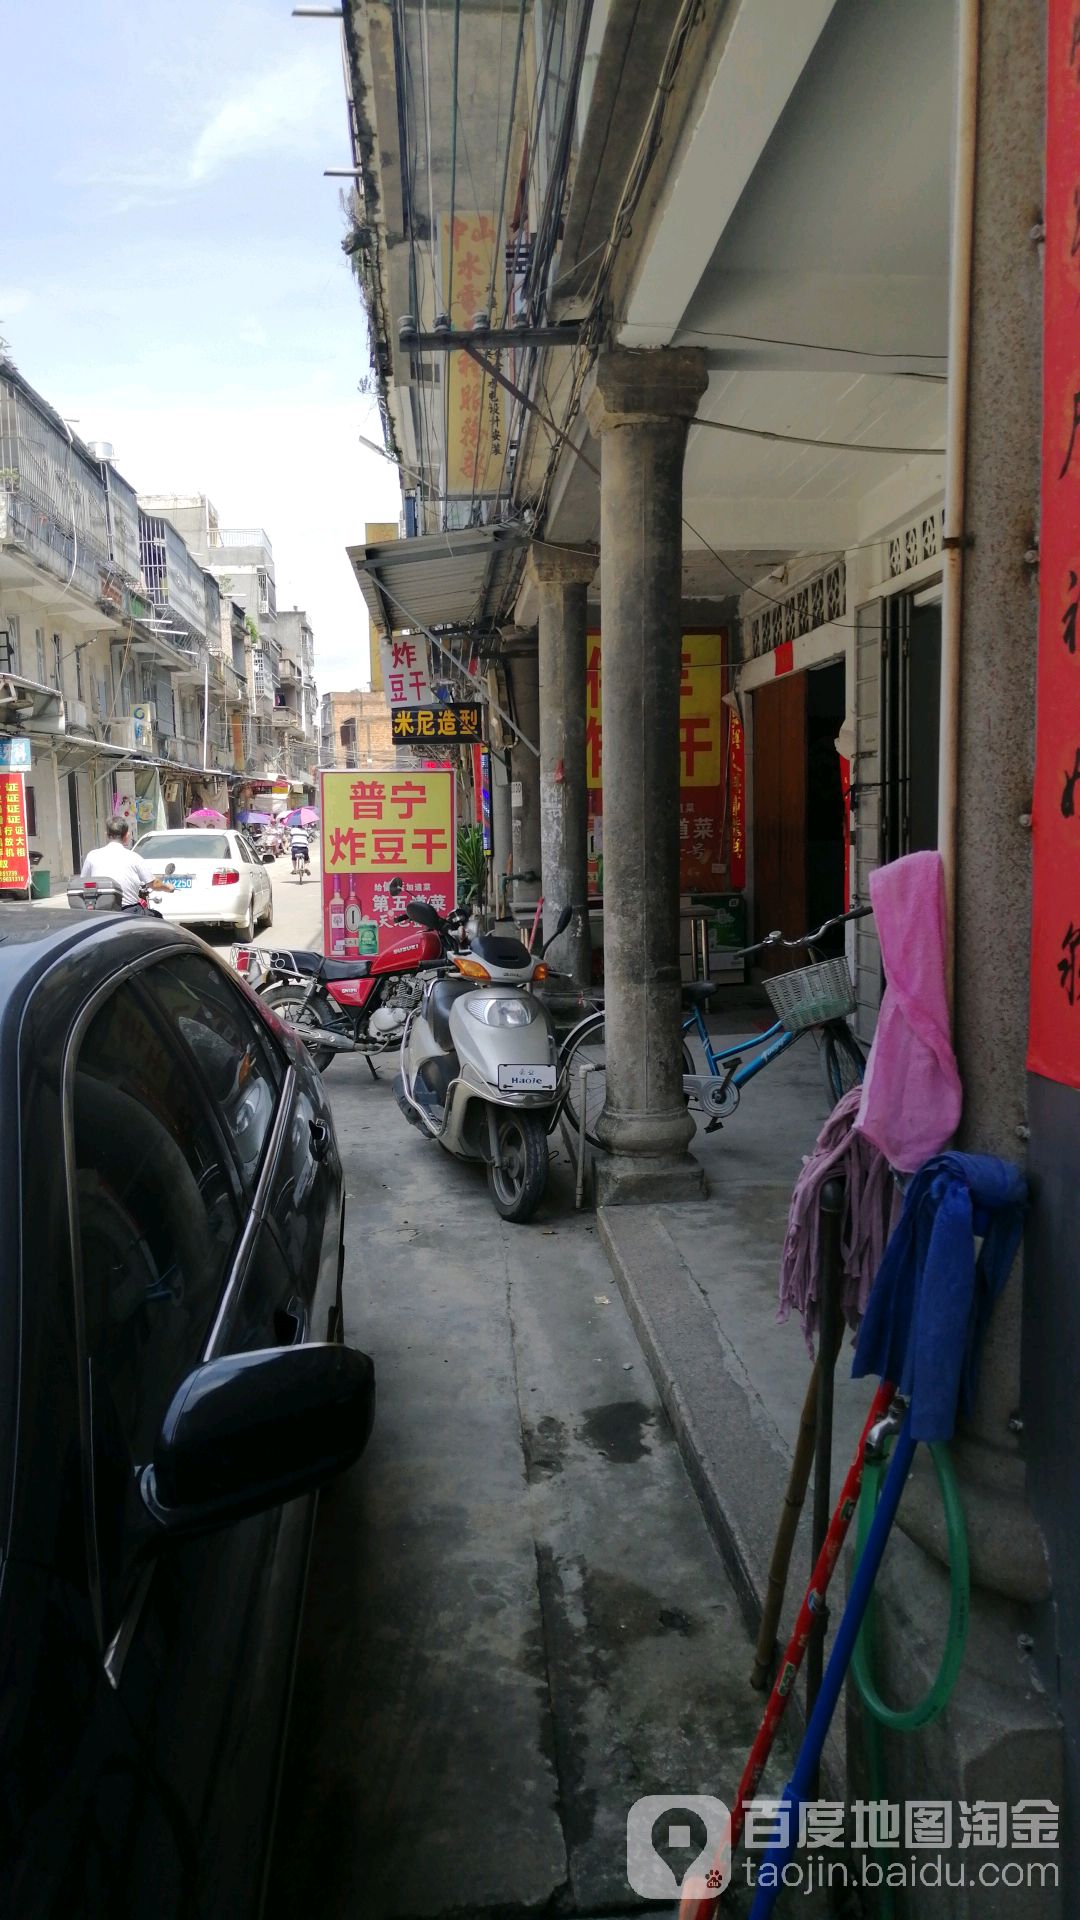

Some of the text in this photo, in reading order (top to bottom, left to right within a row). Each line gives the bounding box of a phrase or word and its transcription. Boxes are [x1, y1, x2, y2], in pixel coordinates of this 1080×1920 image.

[392, 642, 417, 669] 炸
[389, 671, 426, 703] 豆干
[394, 709, 478, 737] 米尼造型
[349, 781, 427, 820] 普宁
[0, 826, 24, 835] 行证
[0, 837, 24, 846] 放大
[0, 848, 25, 857] 机相
[329, 827, 448, 866] 炸豆干
